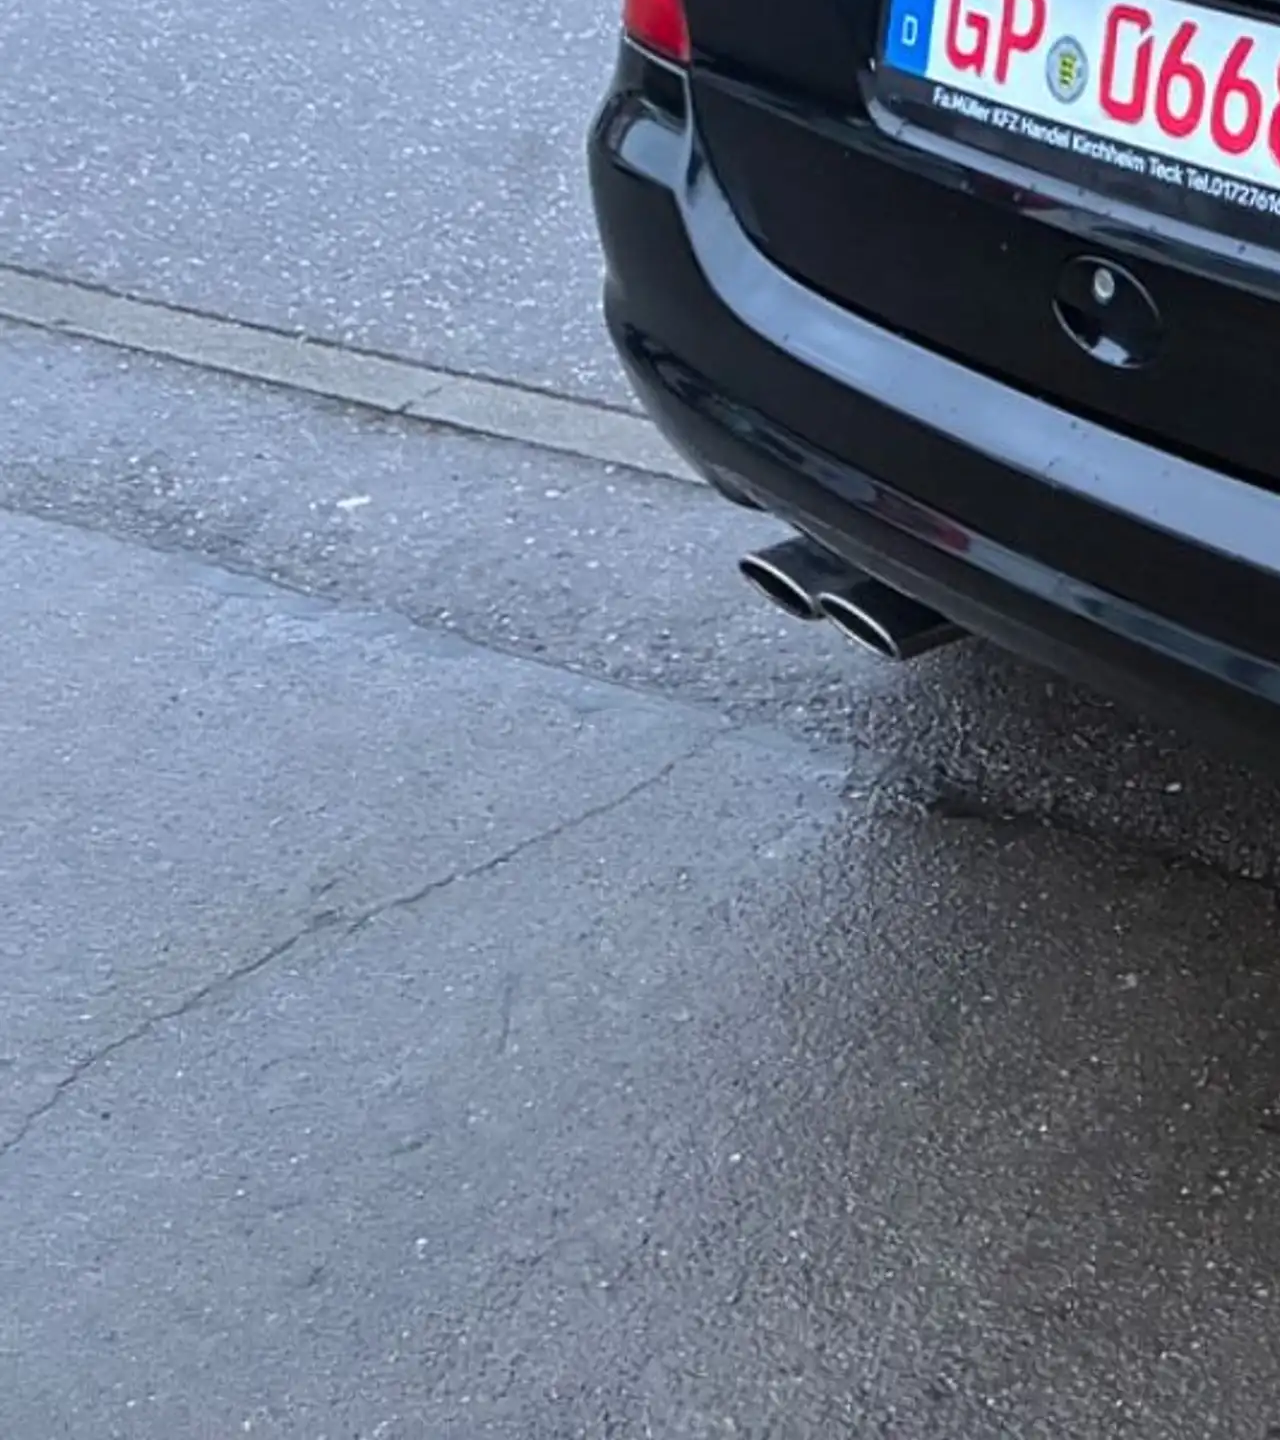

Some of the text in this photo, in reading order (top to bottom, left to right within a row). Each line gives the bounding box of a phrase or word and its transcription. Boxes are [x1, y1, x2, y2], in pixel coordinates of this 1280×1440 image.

[902, 15, 918, 47] D
[991, 107, 1020, 134] KFZ
[1021, 117, 1070, 150] Handel
[1073, 133, 1145, 173] Kirchheim
[1149, 155, 1184, 186] Teck
